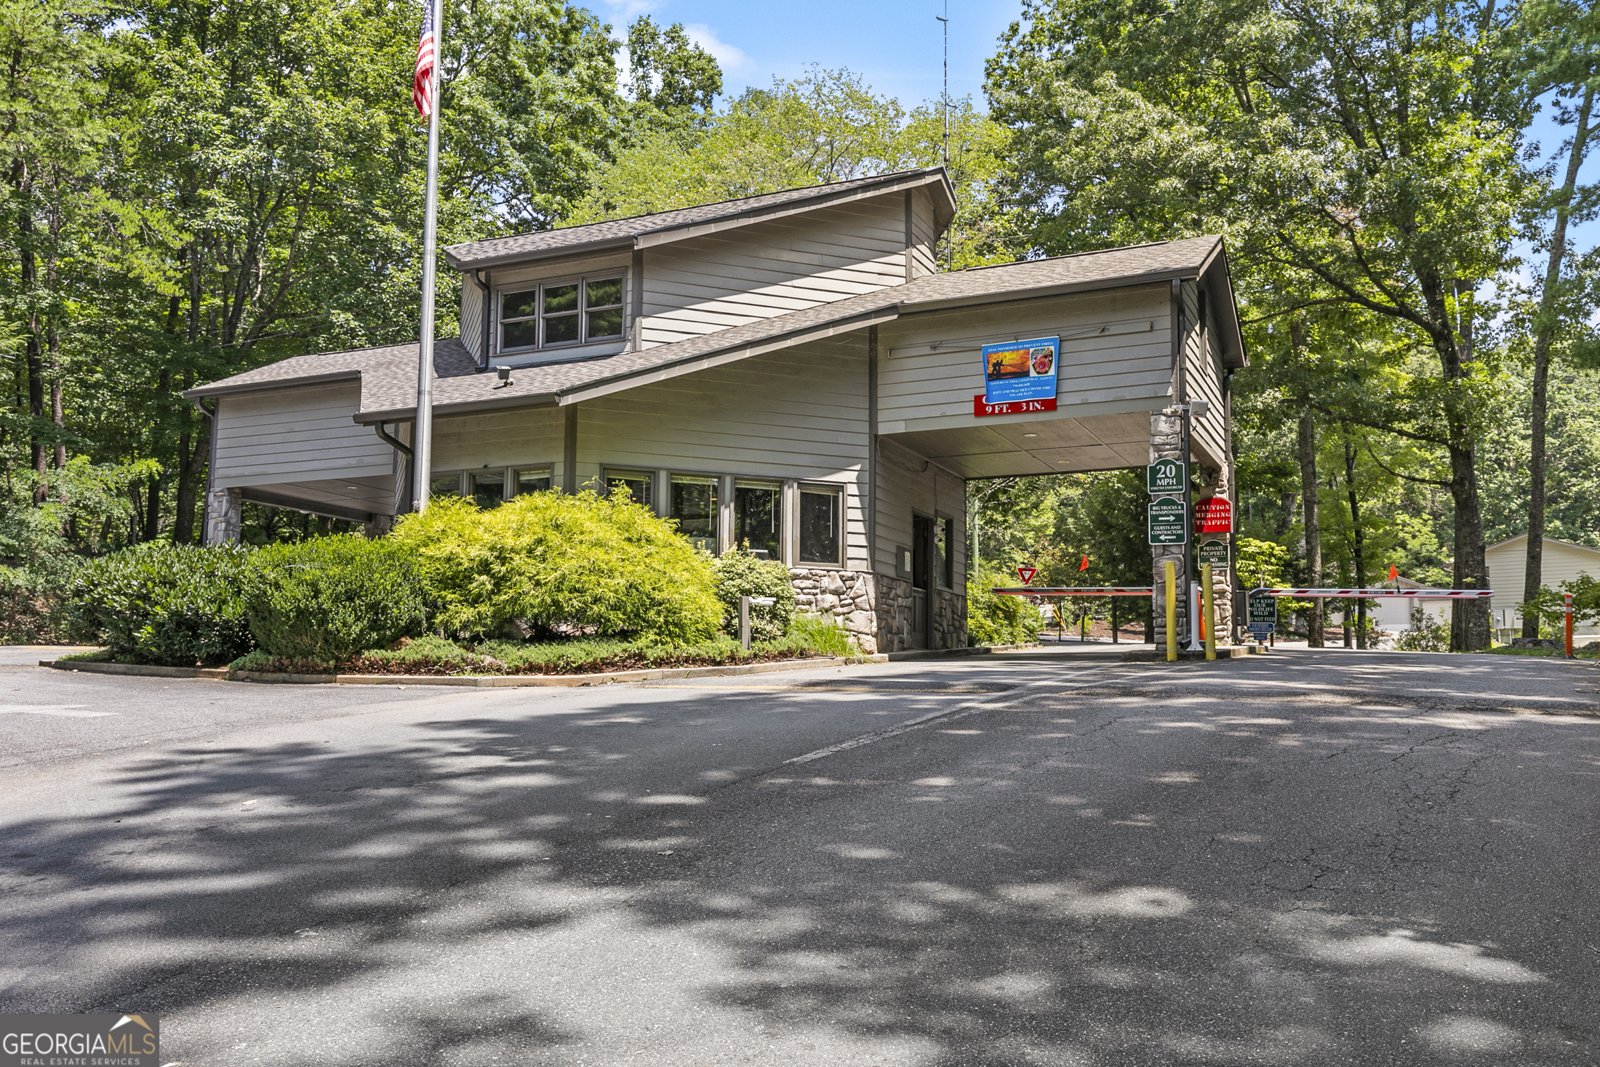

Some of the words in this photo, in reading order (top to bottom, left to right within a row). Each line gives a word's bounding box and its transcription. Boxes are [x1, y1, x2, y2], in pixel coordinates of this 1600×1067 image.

[986, 406, 992, 414] 9
[994, 404, 1011, 413] FT.
[1020, 403, 1026, 411] 3
[1029, 401, 1044, 411] IN.
[1156, 464, 1176, 478] 20
